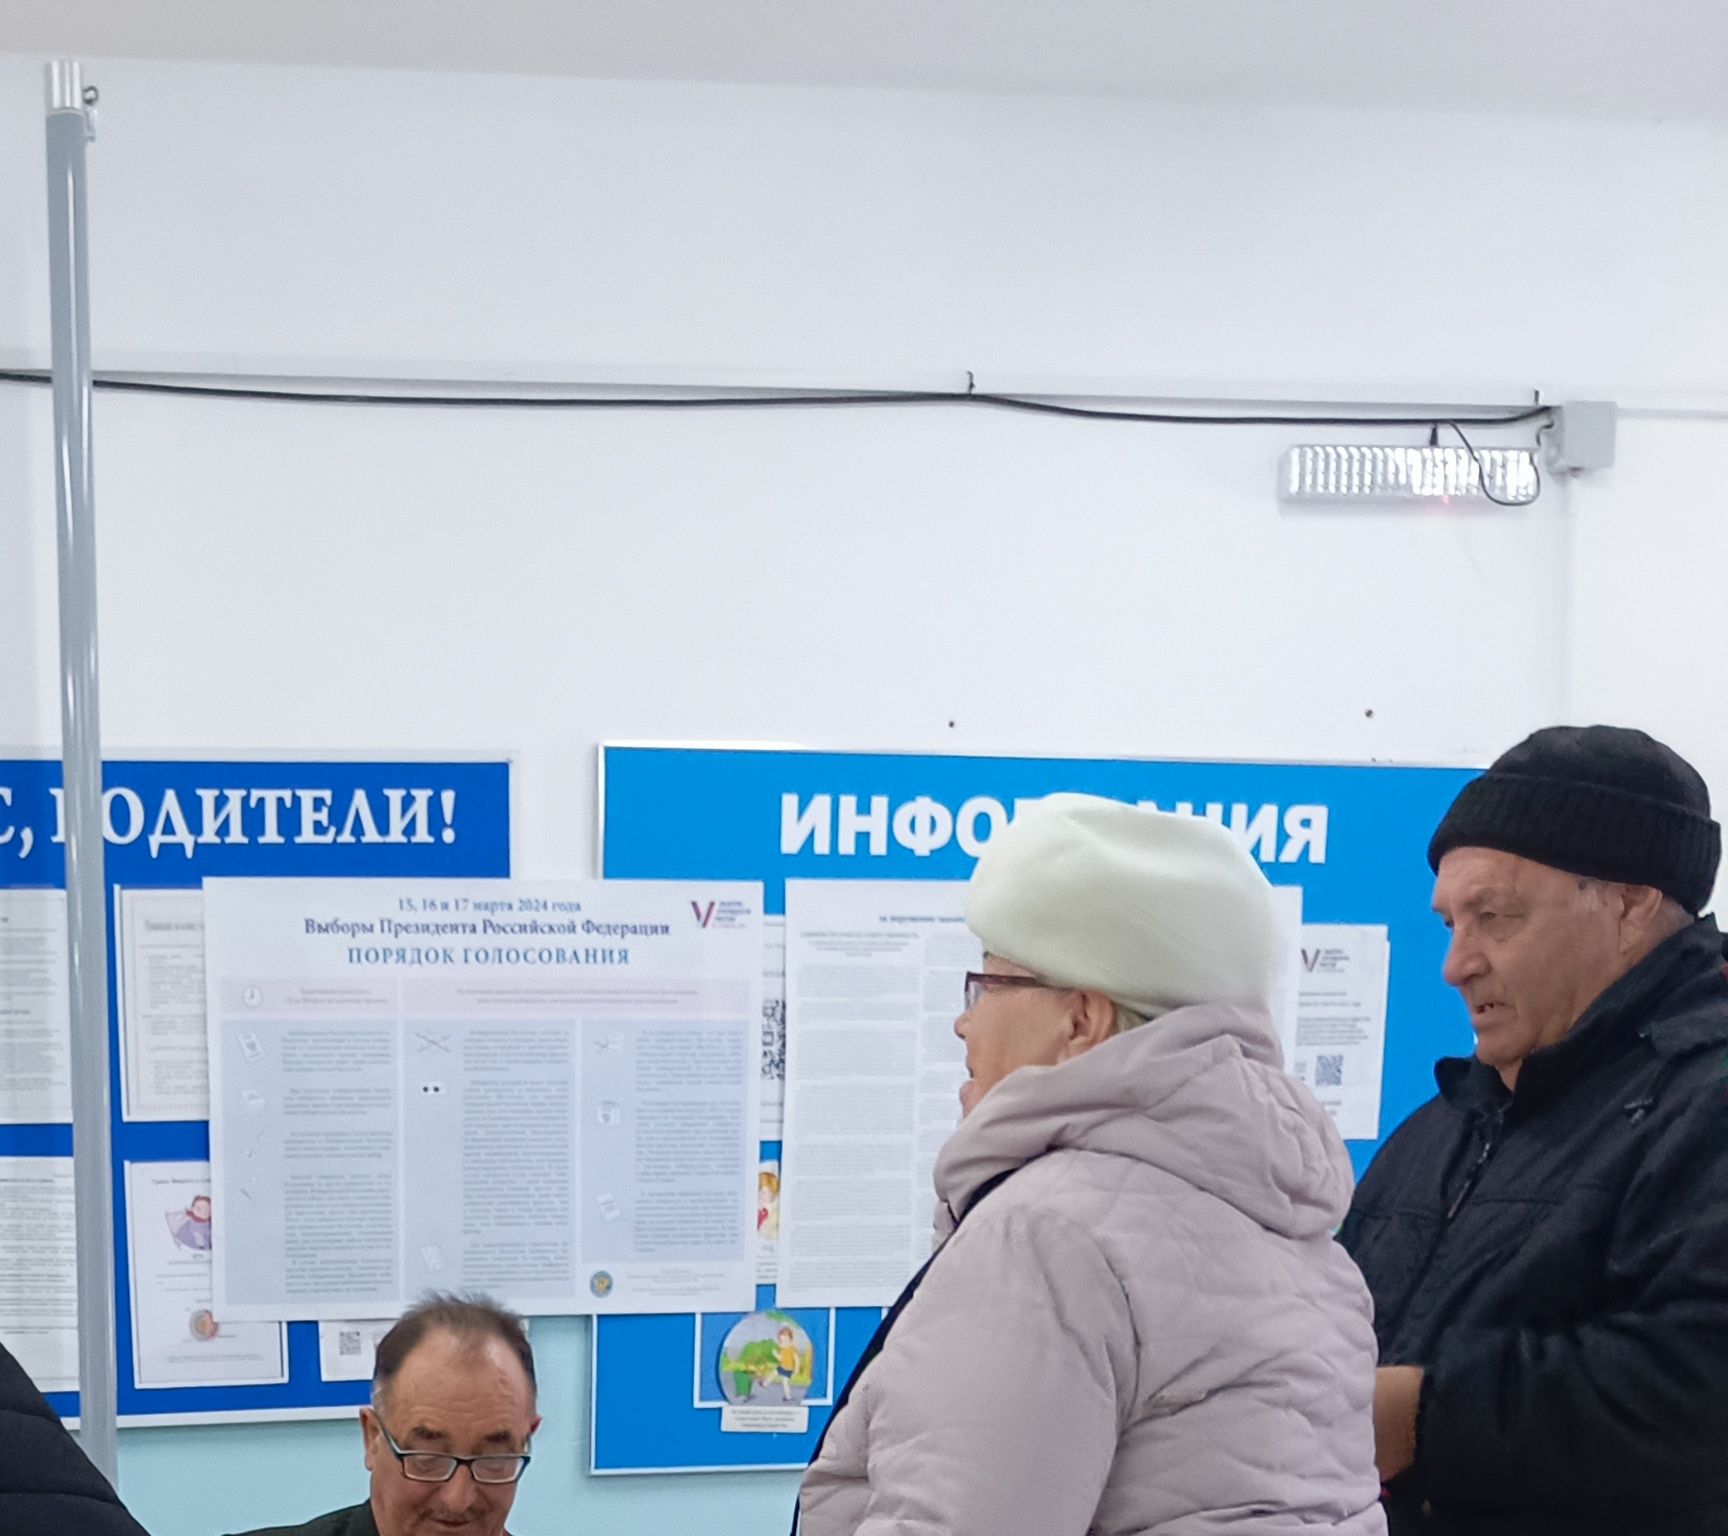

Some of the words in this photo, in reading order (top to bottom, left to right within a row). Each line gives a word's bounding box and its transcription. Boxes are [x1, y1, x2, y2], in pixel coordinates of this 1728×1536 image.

[780, 793, 1329, 864] ИНФОИЯ
[454, 898, 468, 911] 17
[472, 901, 513, 917] марта
[518, 900, 548, 912] 2024
[552, 901, 581, 914] года
[304, 918, 375, 938] Выборы
[379, 918, 477, 938] Президента
[482, 919, 577, 935] Российской
[581, 920, 671, 938] Федерации
[347, 947, 455, 966] ПОРЯДОК
[463, 948, 630, 965] ГОЛОСОВАНИЯ
